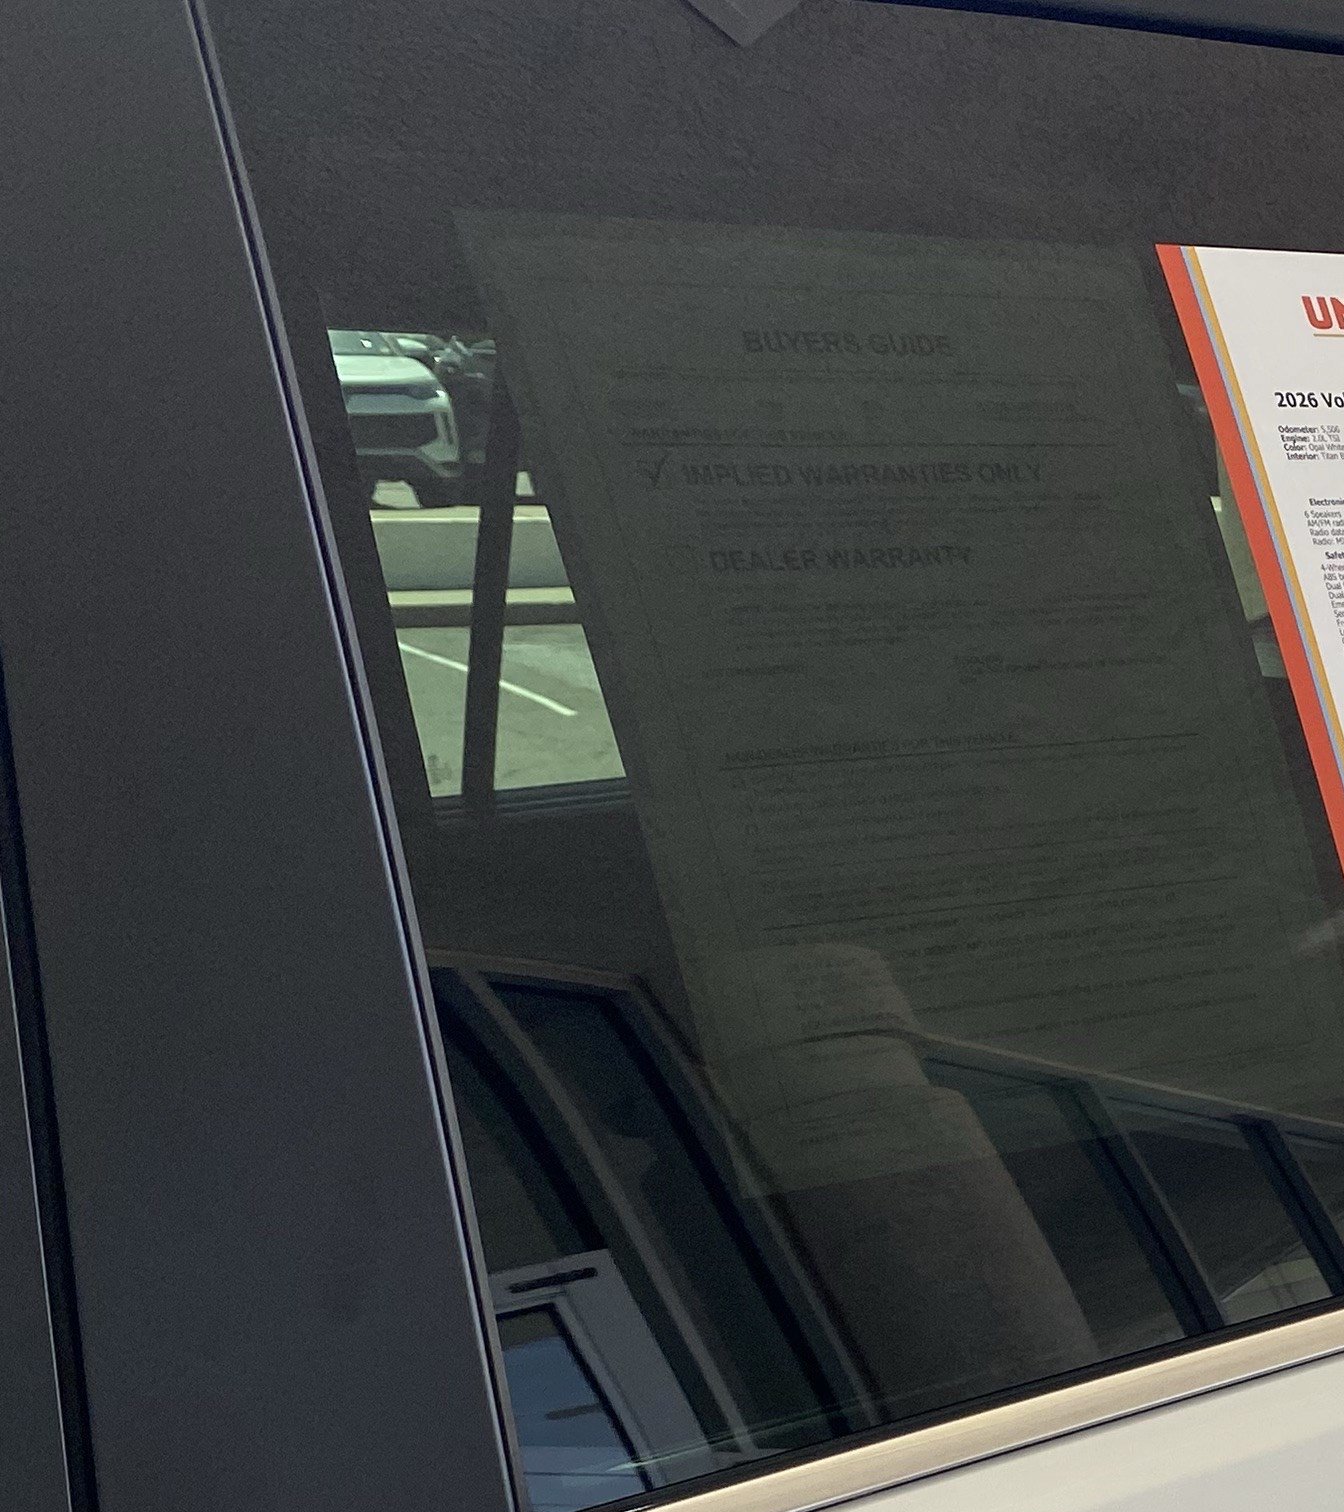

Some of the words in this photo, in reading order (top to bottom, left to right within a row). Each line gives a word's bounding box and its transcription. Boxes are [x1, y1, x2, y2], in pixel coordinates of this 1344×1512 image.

[742, 329, 862, 356] BUYERS
[868, 333, 953, 357] GUIDE
[1274, 391, 1318, 407] 2026
[682, 461, 793, 487] IMPLIED
[800, 461, 972, 486] WARRANTIES
[977, 461, 1043, 485] ONLY
[710, 547, 817, 574] DEALER
[825, 545, 974, 570] WARRANTY
